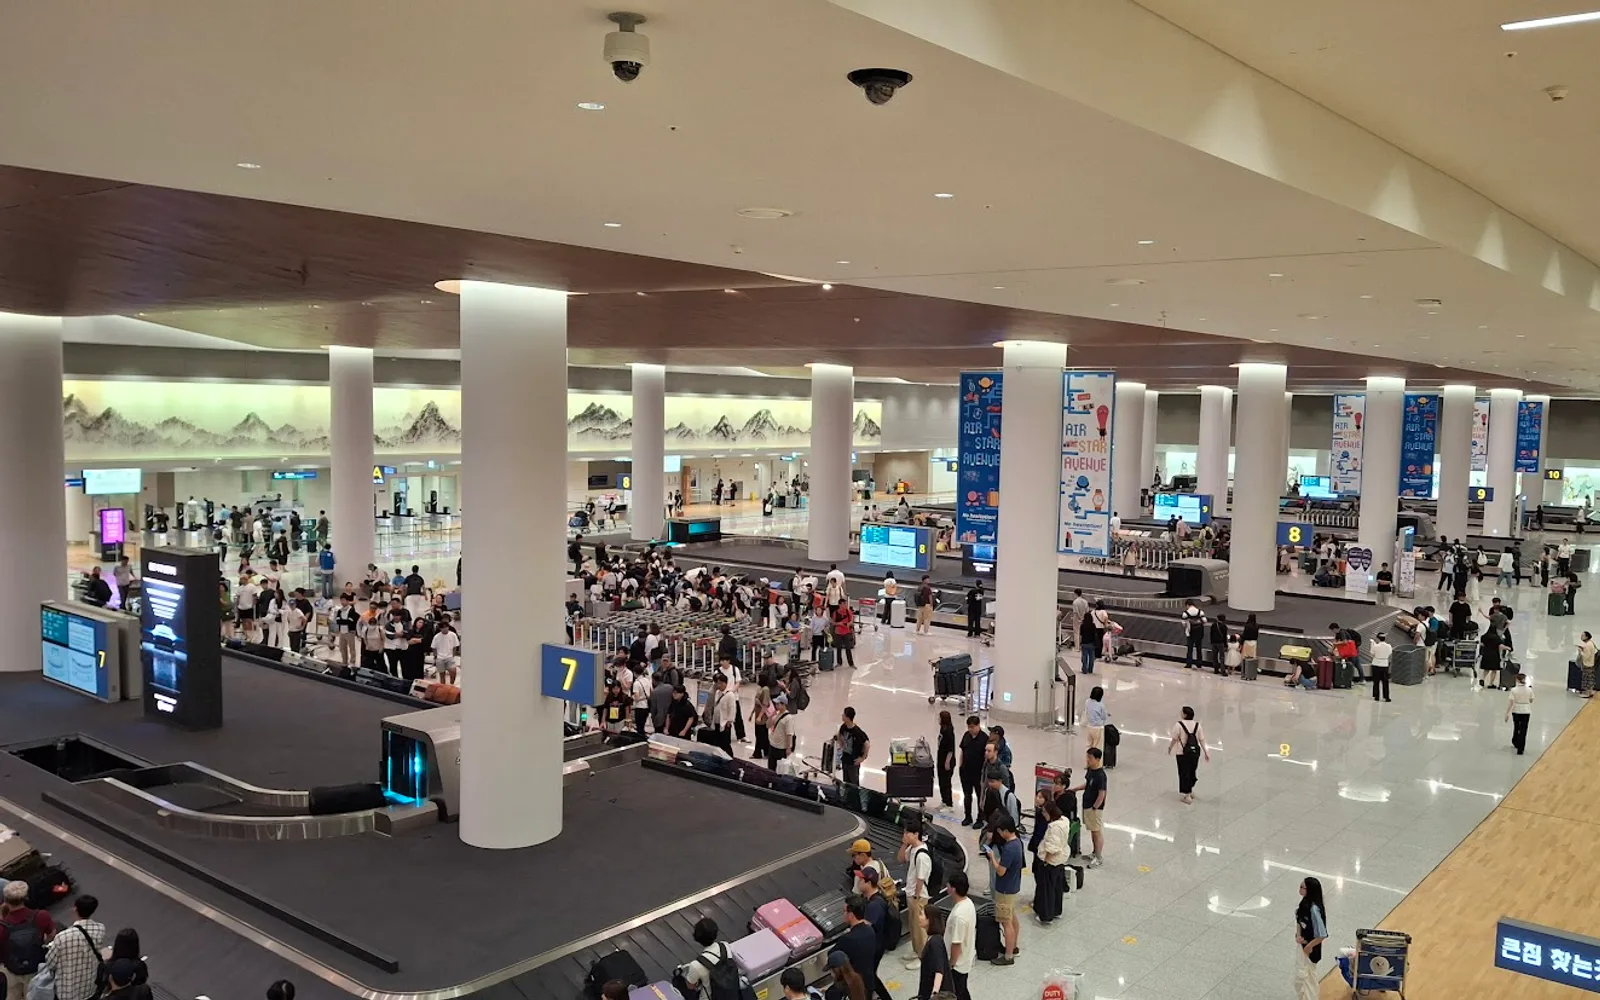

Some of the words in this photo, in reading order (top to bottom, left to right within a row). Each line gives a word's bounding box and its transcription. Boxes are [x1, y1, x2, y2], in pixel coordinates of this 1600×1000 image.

[964, 421, 982, 434] AIR
[1065, 423, 1086, 436] AIR
[974, 436, 1000, 449] STAR
[1078, 439, 1107, 453] STAR
[963, 452, 1000, 467] AVENUE
[1064, 457, 1107, 471] AVENUE
[372, 466, 383, 479] A
[951, 462, 958, 471] 9
[1547, 470, 1560, 479] 10
[622, 476, 630, 488] 8
[1477, 488, 1486, 500] 9
[1202, 505, 1208, 513] 9
[1289, 526, 1301, 543] 8
[919, 544, 926, 554] 8
[98, 651, 106, 668] 7
[561, 657, 577, 690] 7
[1501, 937, 1542, 967] 큰짐
